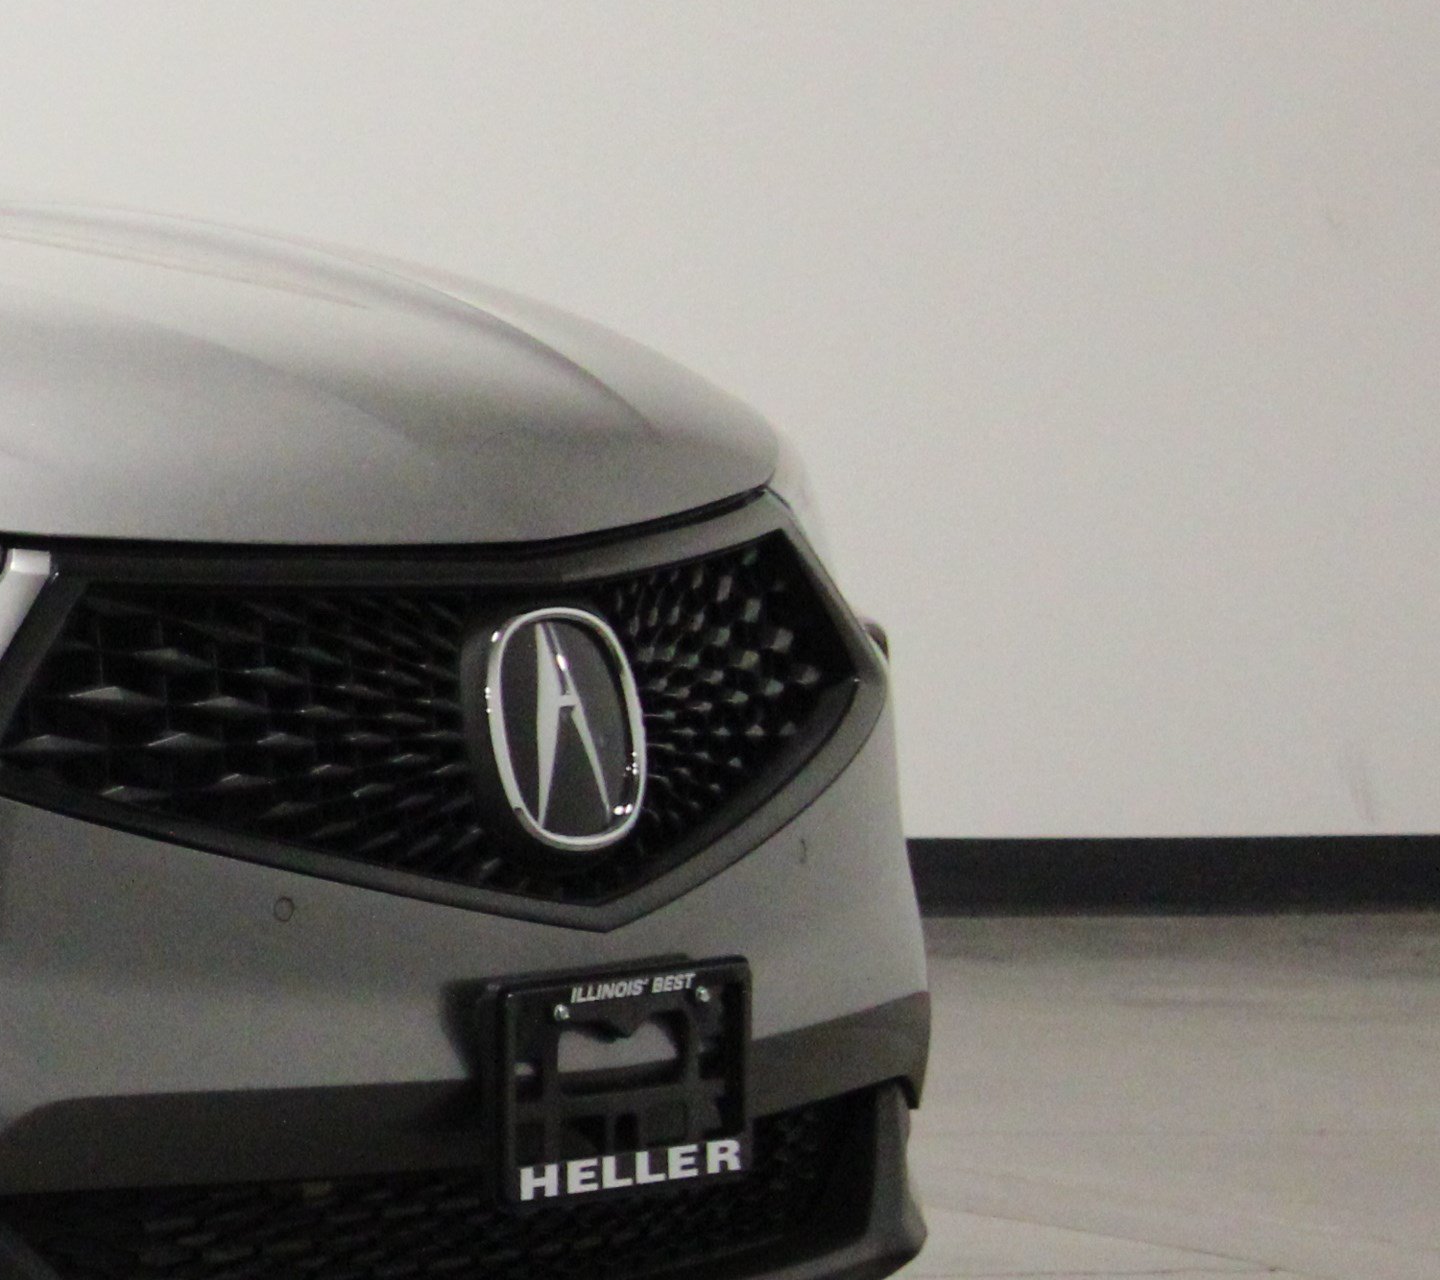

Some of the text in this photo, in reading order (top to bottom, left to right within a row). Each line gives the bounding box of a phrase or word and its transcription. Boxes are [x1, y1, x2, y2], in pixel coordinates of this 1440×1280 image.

[569, 972, 697, 1004] ILLINOIS' BEST
[519, 1138, 742, 1202] HELLER
